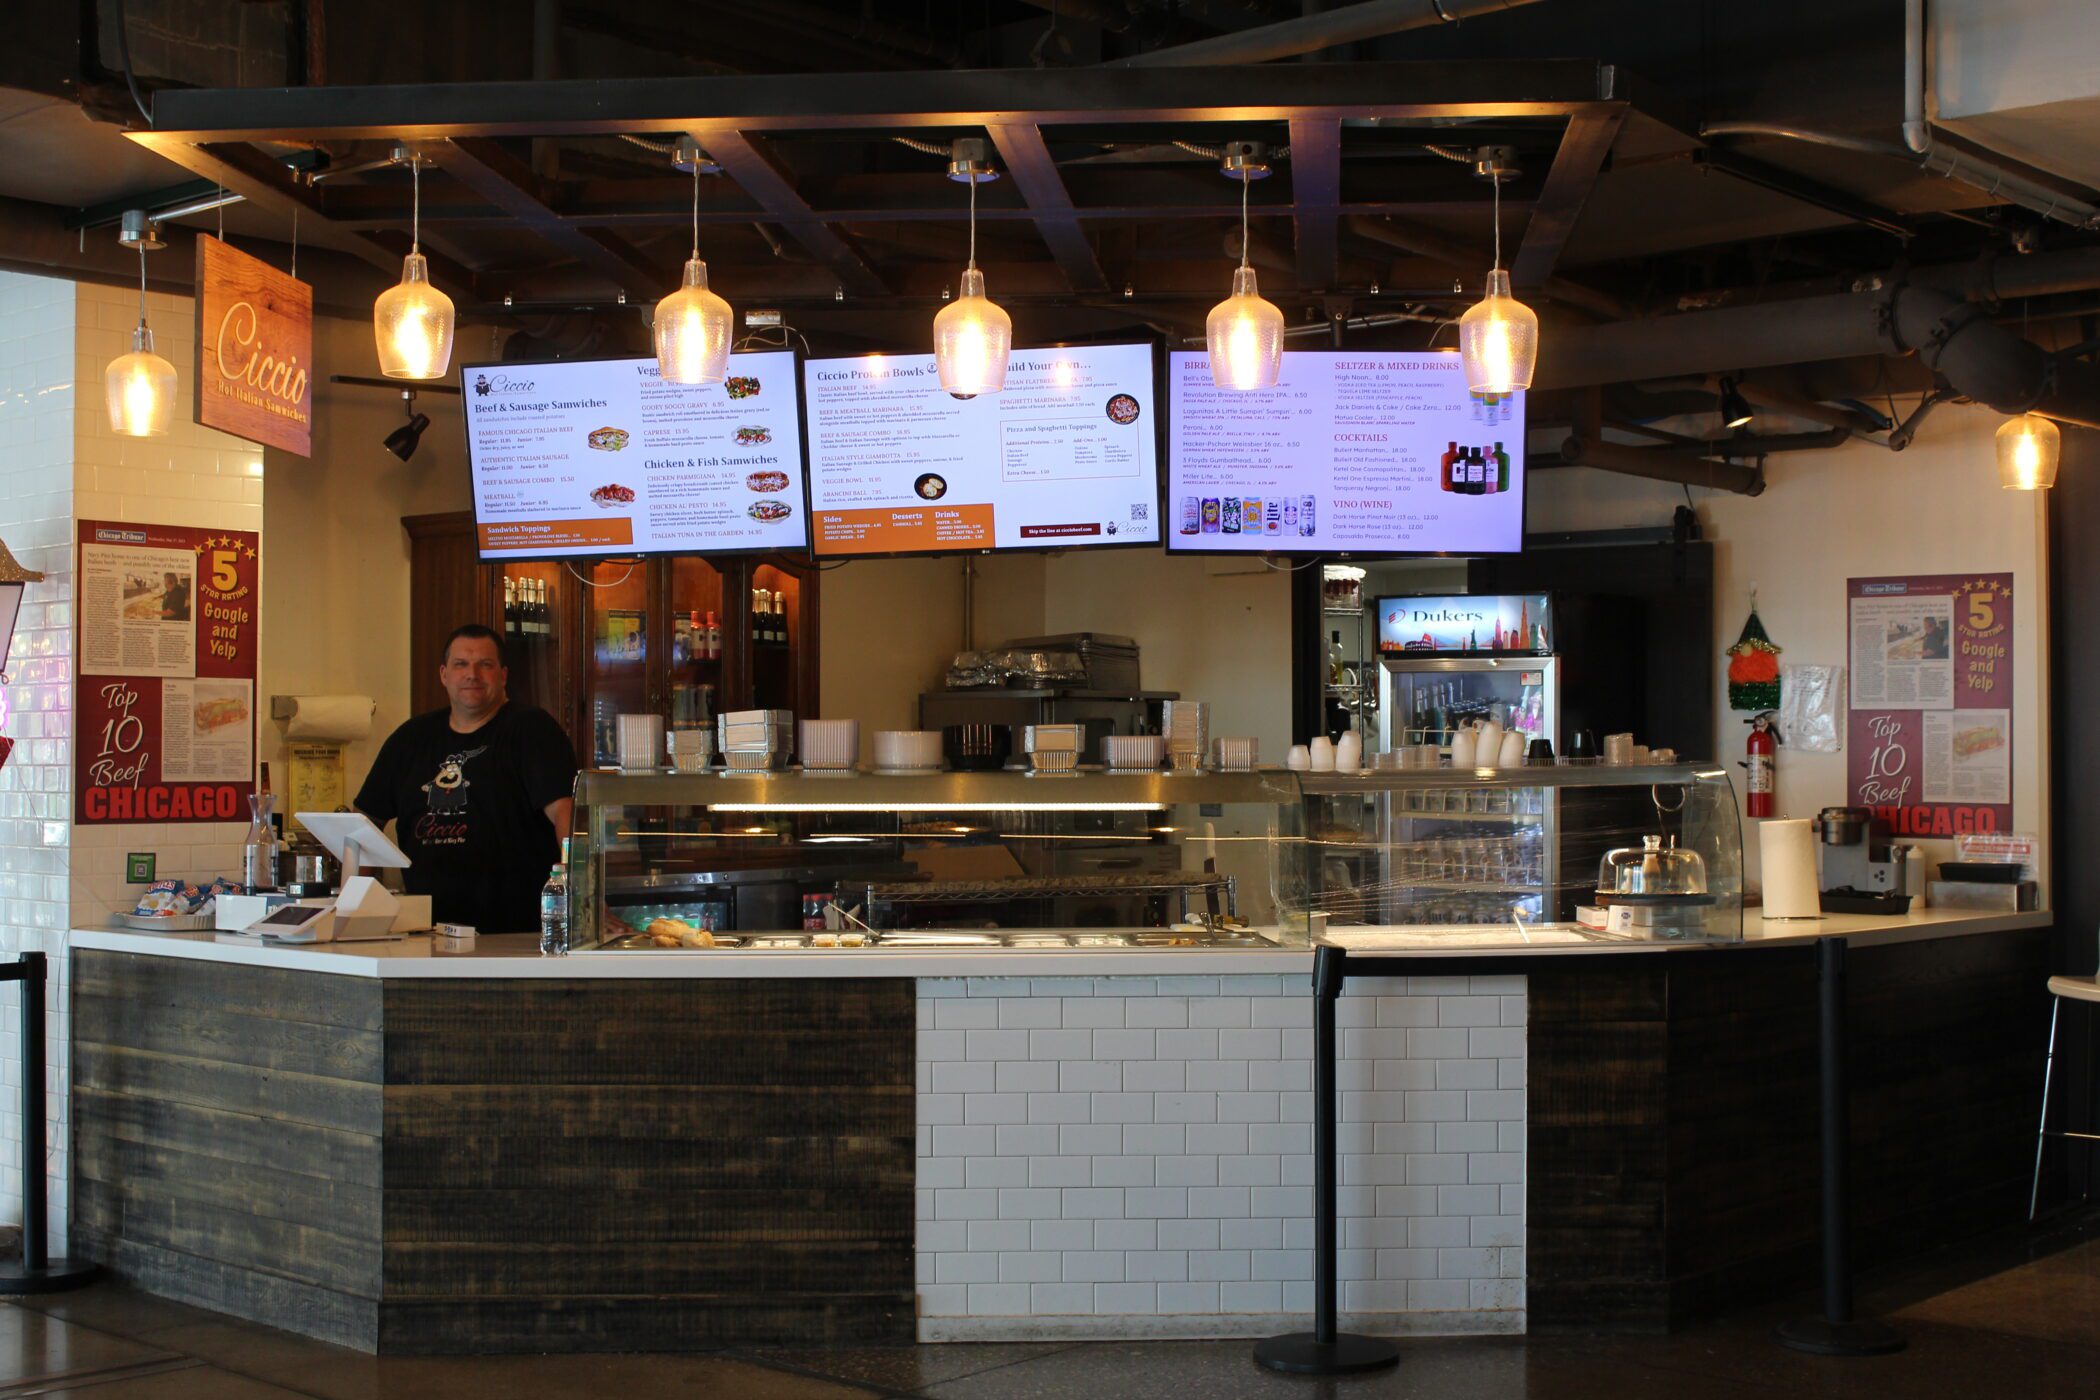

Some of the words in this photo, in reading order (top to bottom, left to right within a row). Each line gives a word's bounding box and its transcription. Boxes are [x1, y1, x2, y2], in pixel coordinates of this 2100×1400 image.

[218, 302, 307, 404] Ciccio
[818, 371, 848, 381] Ciccio
[893, 367, 924, 377] Bowls
[1028, 362, 1050, 371] Your
[490, 374, 535, 393] Ciccio
[218, 380, 234, 397] Hot
[236, 388, 264, 408] Italian
[264, 400, 307, 423] Samwiches
[476, 404, 497, 413] Beef
[499, 404, 507, 412] &
[509, 402, 549, 413] Sausage
[552, 400, 608, 410] Samwiches
[1038, 425, 1067, 433] Spaghetti
[1069, 424, 1098, 432] Toppings
[645, 459, 684, 469] Chicken
[687, 458, 694, 467] &
[698, 457, 719, 467] Fish
[721, 455, 778, 466] Samwiches
[1267, 502, 1280, 521] Lite
[1360, 501, 1393, 510] (WINE)
[98, 530, 121, 540] Chicago
[121, 531, 145, 542] Tribune
[521, 525, 551, 533] Toppings
[1116, 521, 1148, 534] Ciccio
[212, 550, 238, 591] 5
[200, 584, 220, 599] STAR
[222, 585, 249, 600] RATING
[204, 602, 249, 624] Google
[1413, 609, 1483, 622] Dukers
[1968, 592, 1994, 630] 5
[212, 624, 238, 640] and
[1958, 624, 1976, 638] STAR
[1978, 624, 2005, 639] RATING
[210, 640, 237, 660] Yelp
[1962, 640, 2005, 658] Google
[1968, 660, 1994, 673] and
[1968, 675, 1994, 693] Yelp
[101, 682, 138, 718] Top
[97, 715, 144, 758] 10
[1868, 715, 1901, 746] Top
[1865, 743, 1906, 780] 10
[90, 752, 149, 790] Beef
[1858, 776, 1911, 808] Beef
[84, 786, 237, 820] CHICAGO
[416, 814, 468, 839] Ciccio
